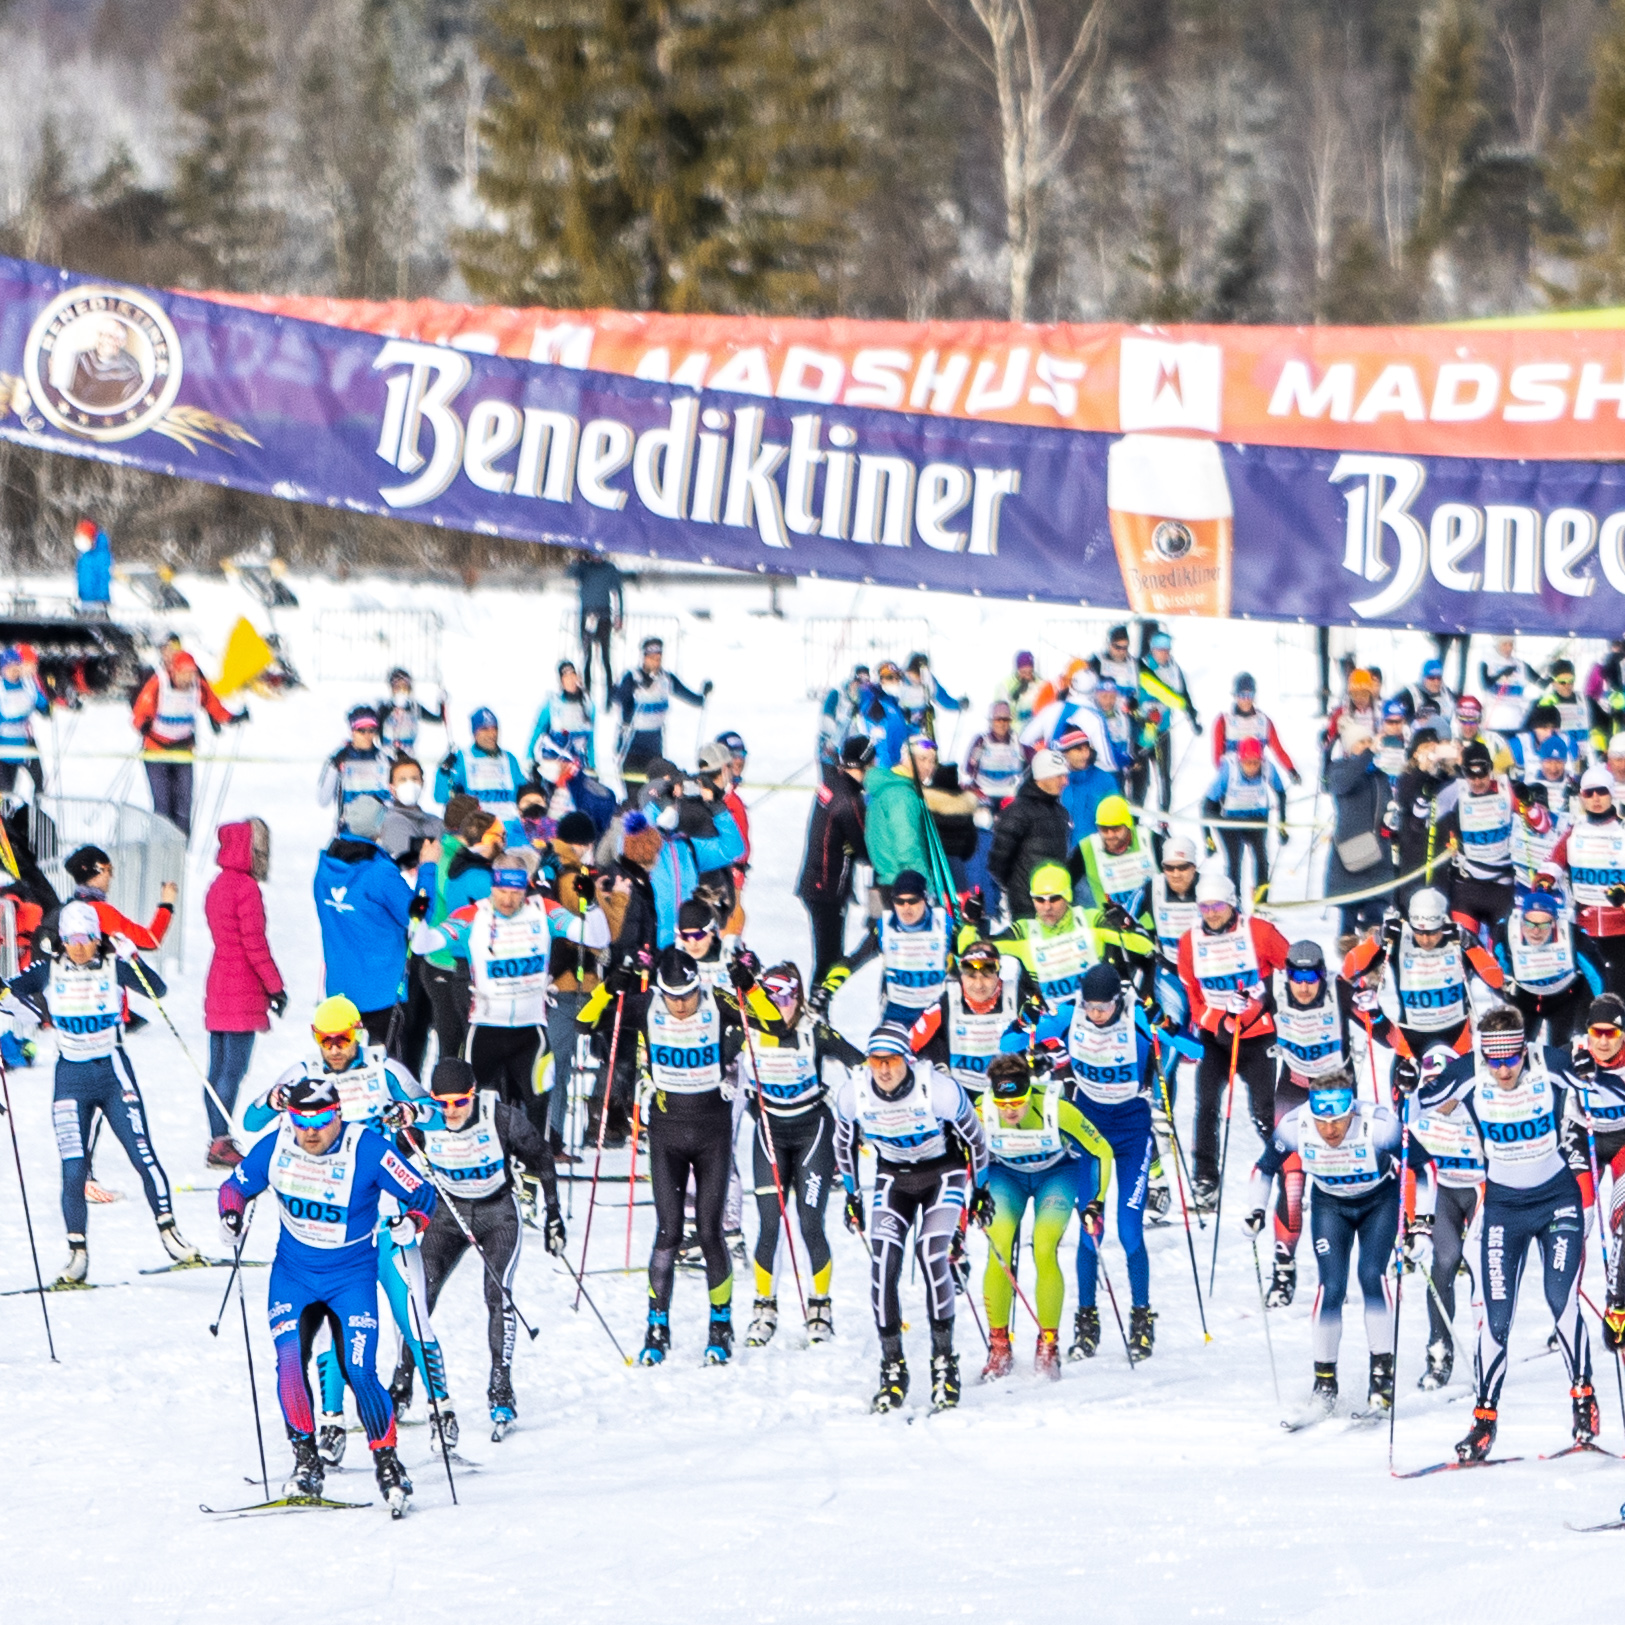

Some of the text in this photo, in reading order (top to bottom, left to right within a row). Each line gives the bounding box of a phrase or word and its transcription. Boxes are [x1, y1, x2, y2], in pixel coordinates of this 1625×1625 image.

[372, 336, 1020, 557] Benediktiner
[1574, 867, 1625, 884] 4003
[1406, 988, 1458, 1008] 4013
[657, 1046, 714, 1068] 6008
[1487, 1115, 1551, 1142] 6003
[393, 1165, 420, 1192] LOTOS
[804, 1172, 822, 1208] swix
[1488, 1226, 1508, 1301] SKG Gersfeld
[1552, 1236, 1570, 1271] swix
[351, 1331, 368, 1367] swix
[501, 1309, 516, 1367] TERREX
